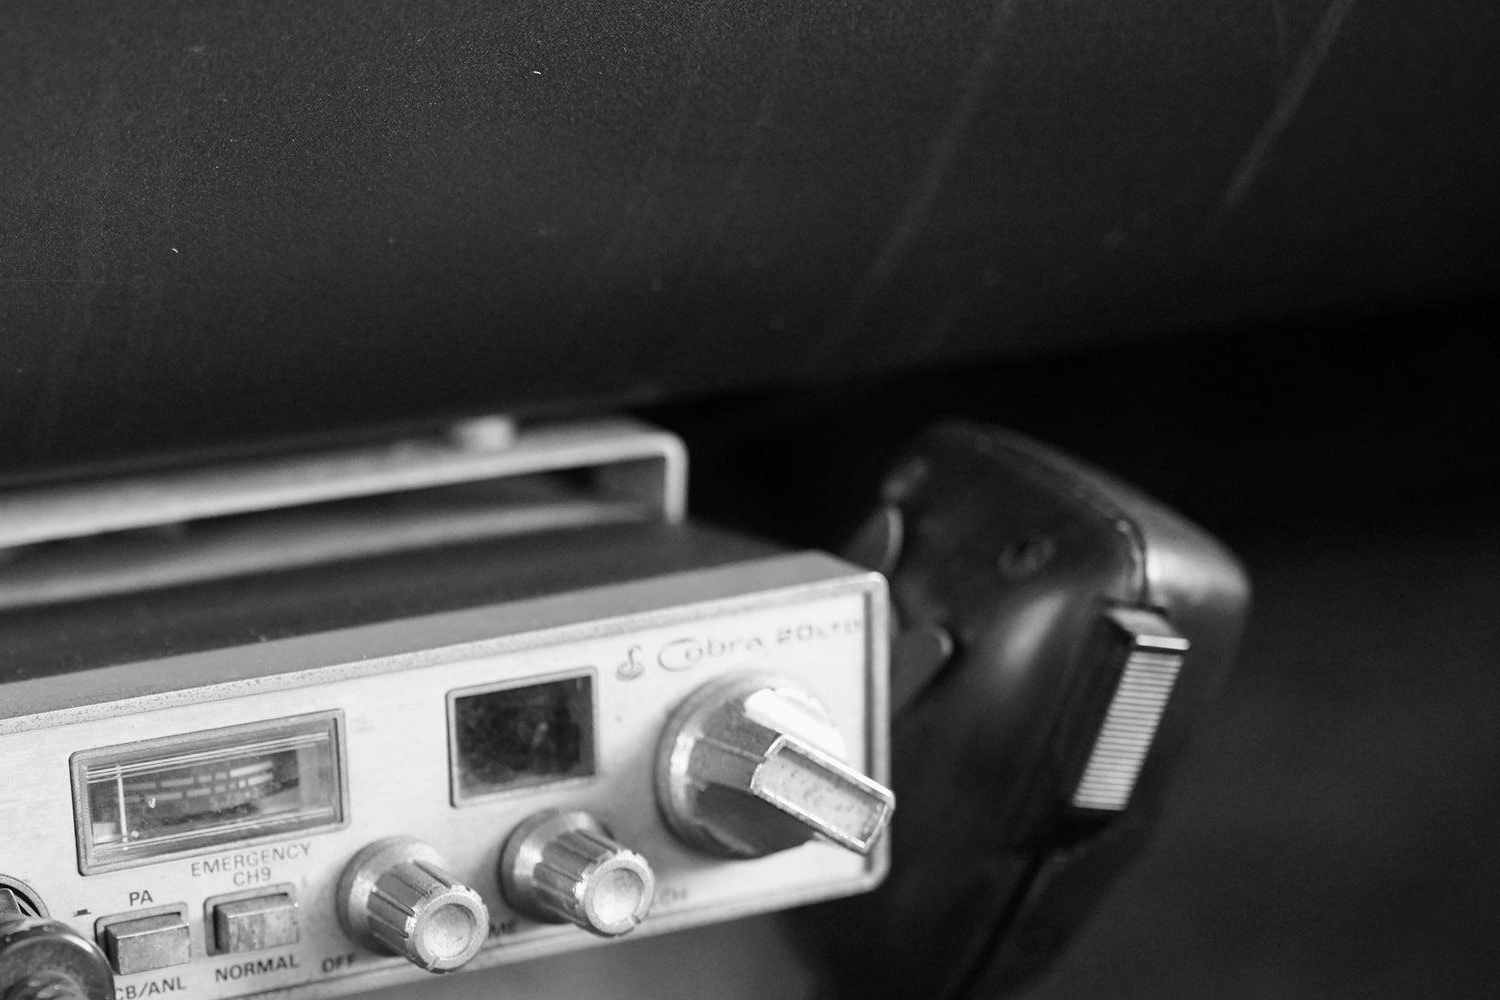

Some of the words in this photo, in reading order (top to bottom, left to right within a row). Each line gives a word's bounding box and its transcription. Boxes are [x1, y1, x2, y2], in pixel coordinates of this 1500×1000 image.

[657, 637, 770, 673] Cobra
[191, 842, 312, 878] EMERGENCY
[233, 867, 271, 887] CH9
[129, 890, 154, 906] PA
[215, 955, 299, 983] NORMAL
[321, 951, 357, 974] OFF
